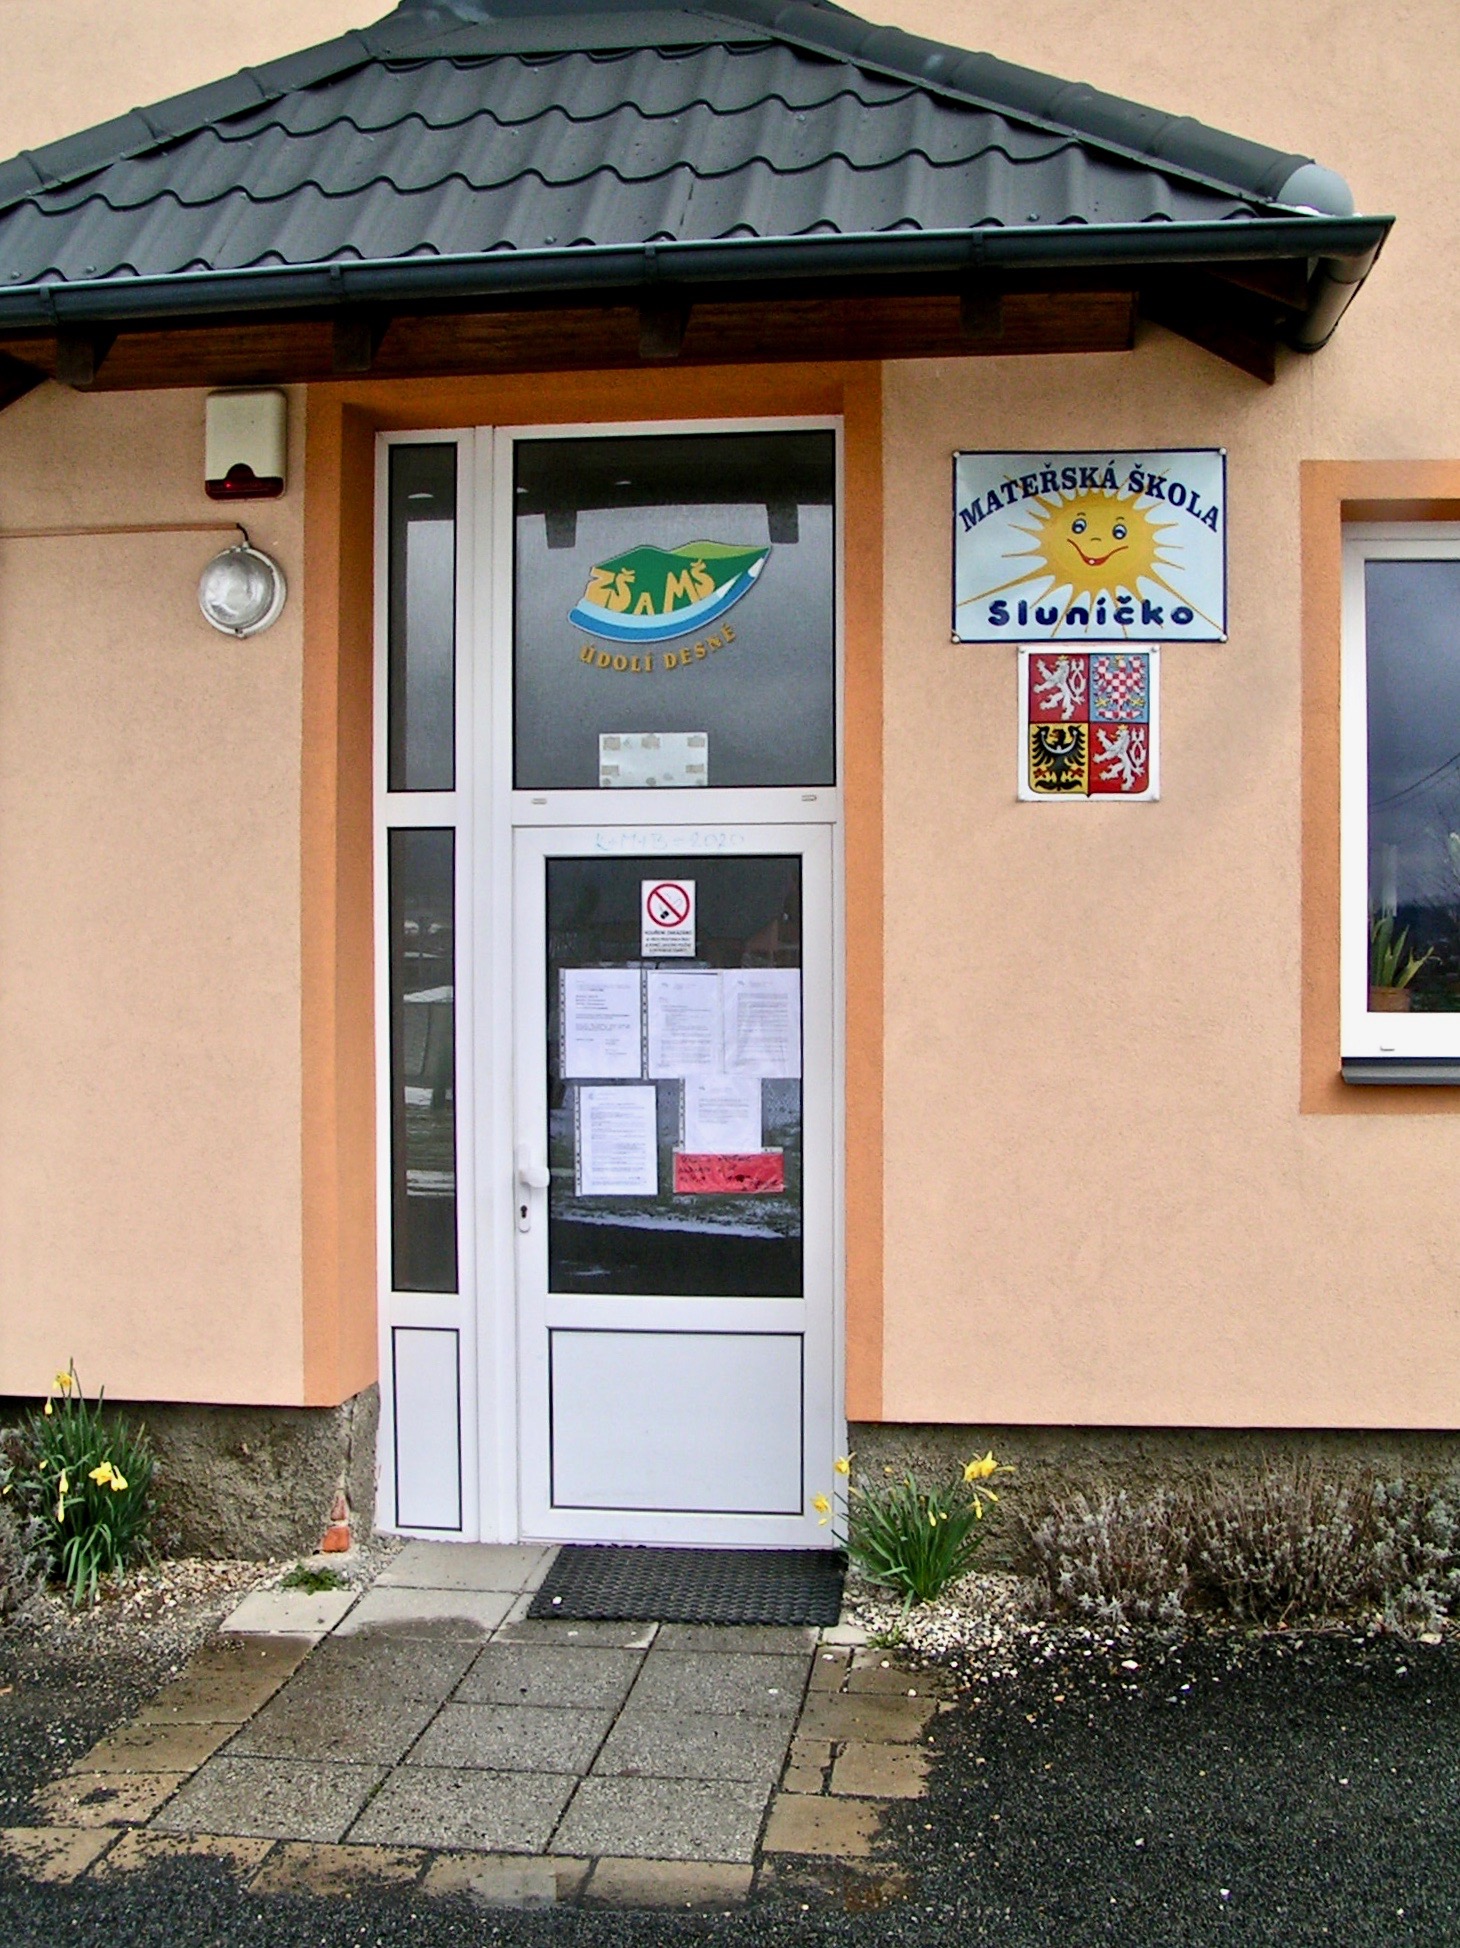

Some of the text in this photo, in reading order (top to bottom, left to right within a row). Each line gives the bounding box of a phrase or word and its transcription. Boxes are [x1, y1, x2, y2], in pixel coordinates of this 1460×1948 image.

[958, 460, 1221, 533] MATEŘSKÁ ŠKOLA
[663, 558, 716, 614] MŠ
[988, 595, 1195, 627] Sluníčko
[580, 645, 653, 672] ÚDOLÍ
